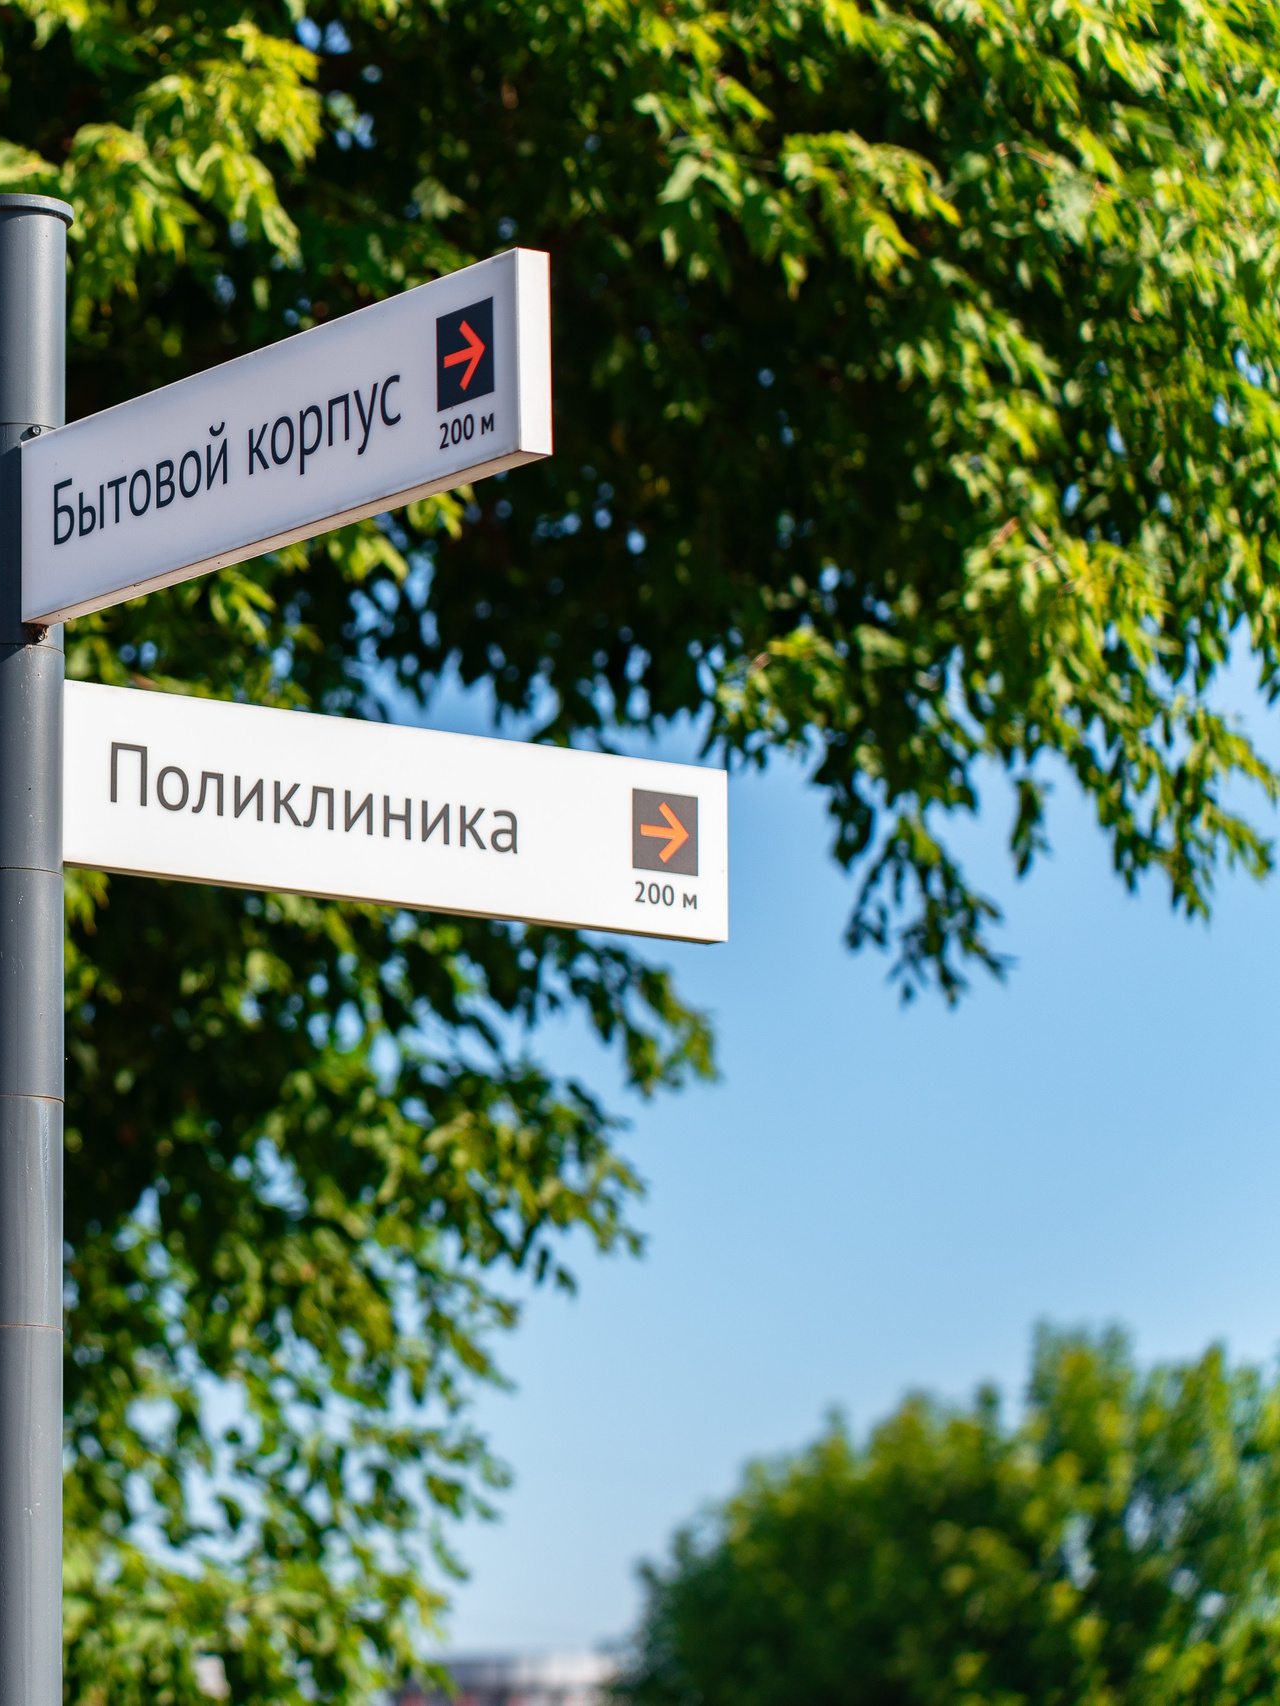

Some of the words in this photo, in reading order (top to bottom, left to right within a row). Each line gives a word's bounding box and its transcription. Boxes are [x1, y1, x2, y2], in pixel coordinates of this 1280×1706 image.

[53, 421, 228, 546] Бытовой
[248, 374, 402, 476] корпус
[438, 413, 475, 450] 200
[481, 412, 495, 436] м
[110, 741, 519, 855] Поликлиника
[634, 880, 675, 907] 200
[682, 893, 698, 910] м
